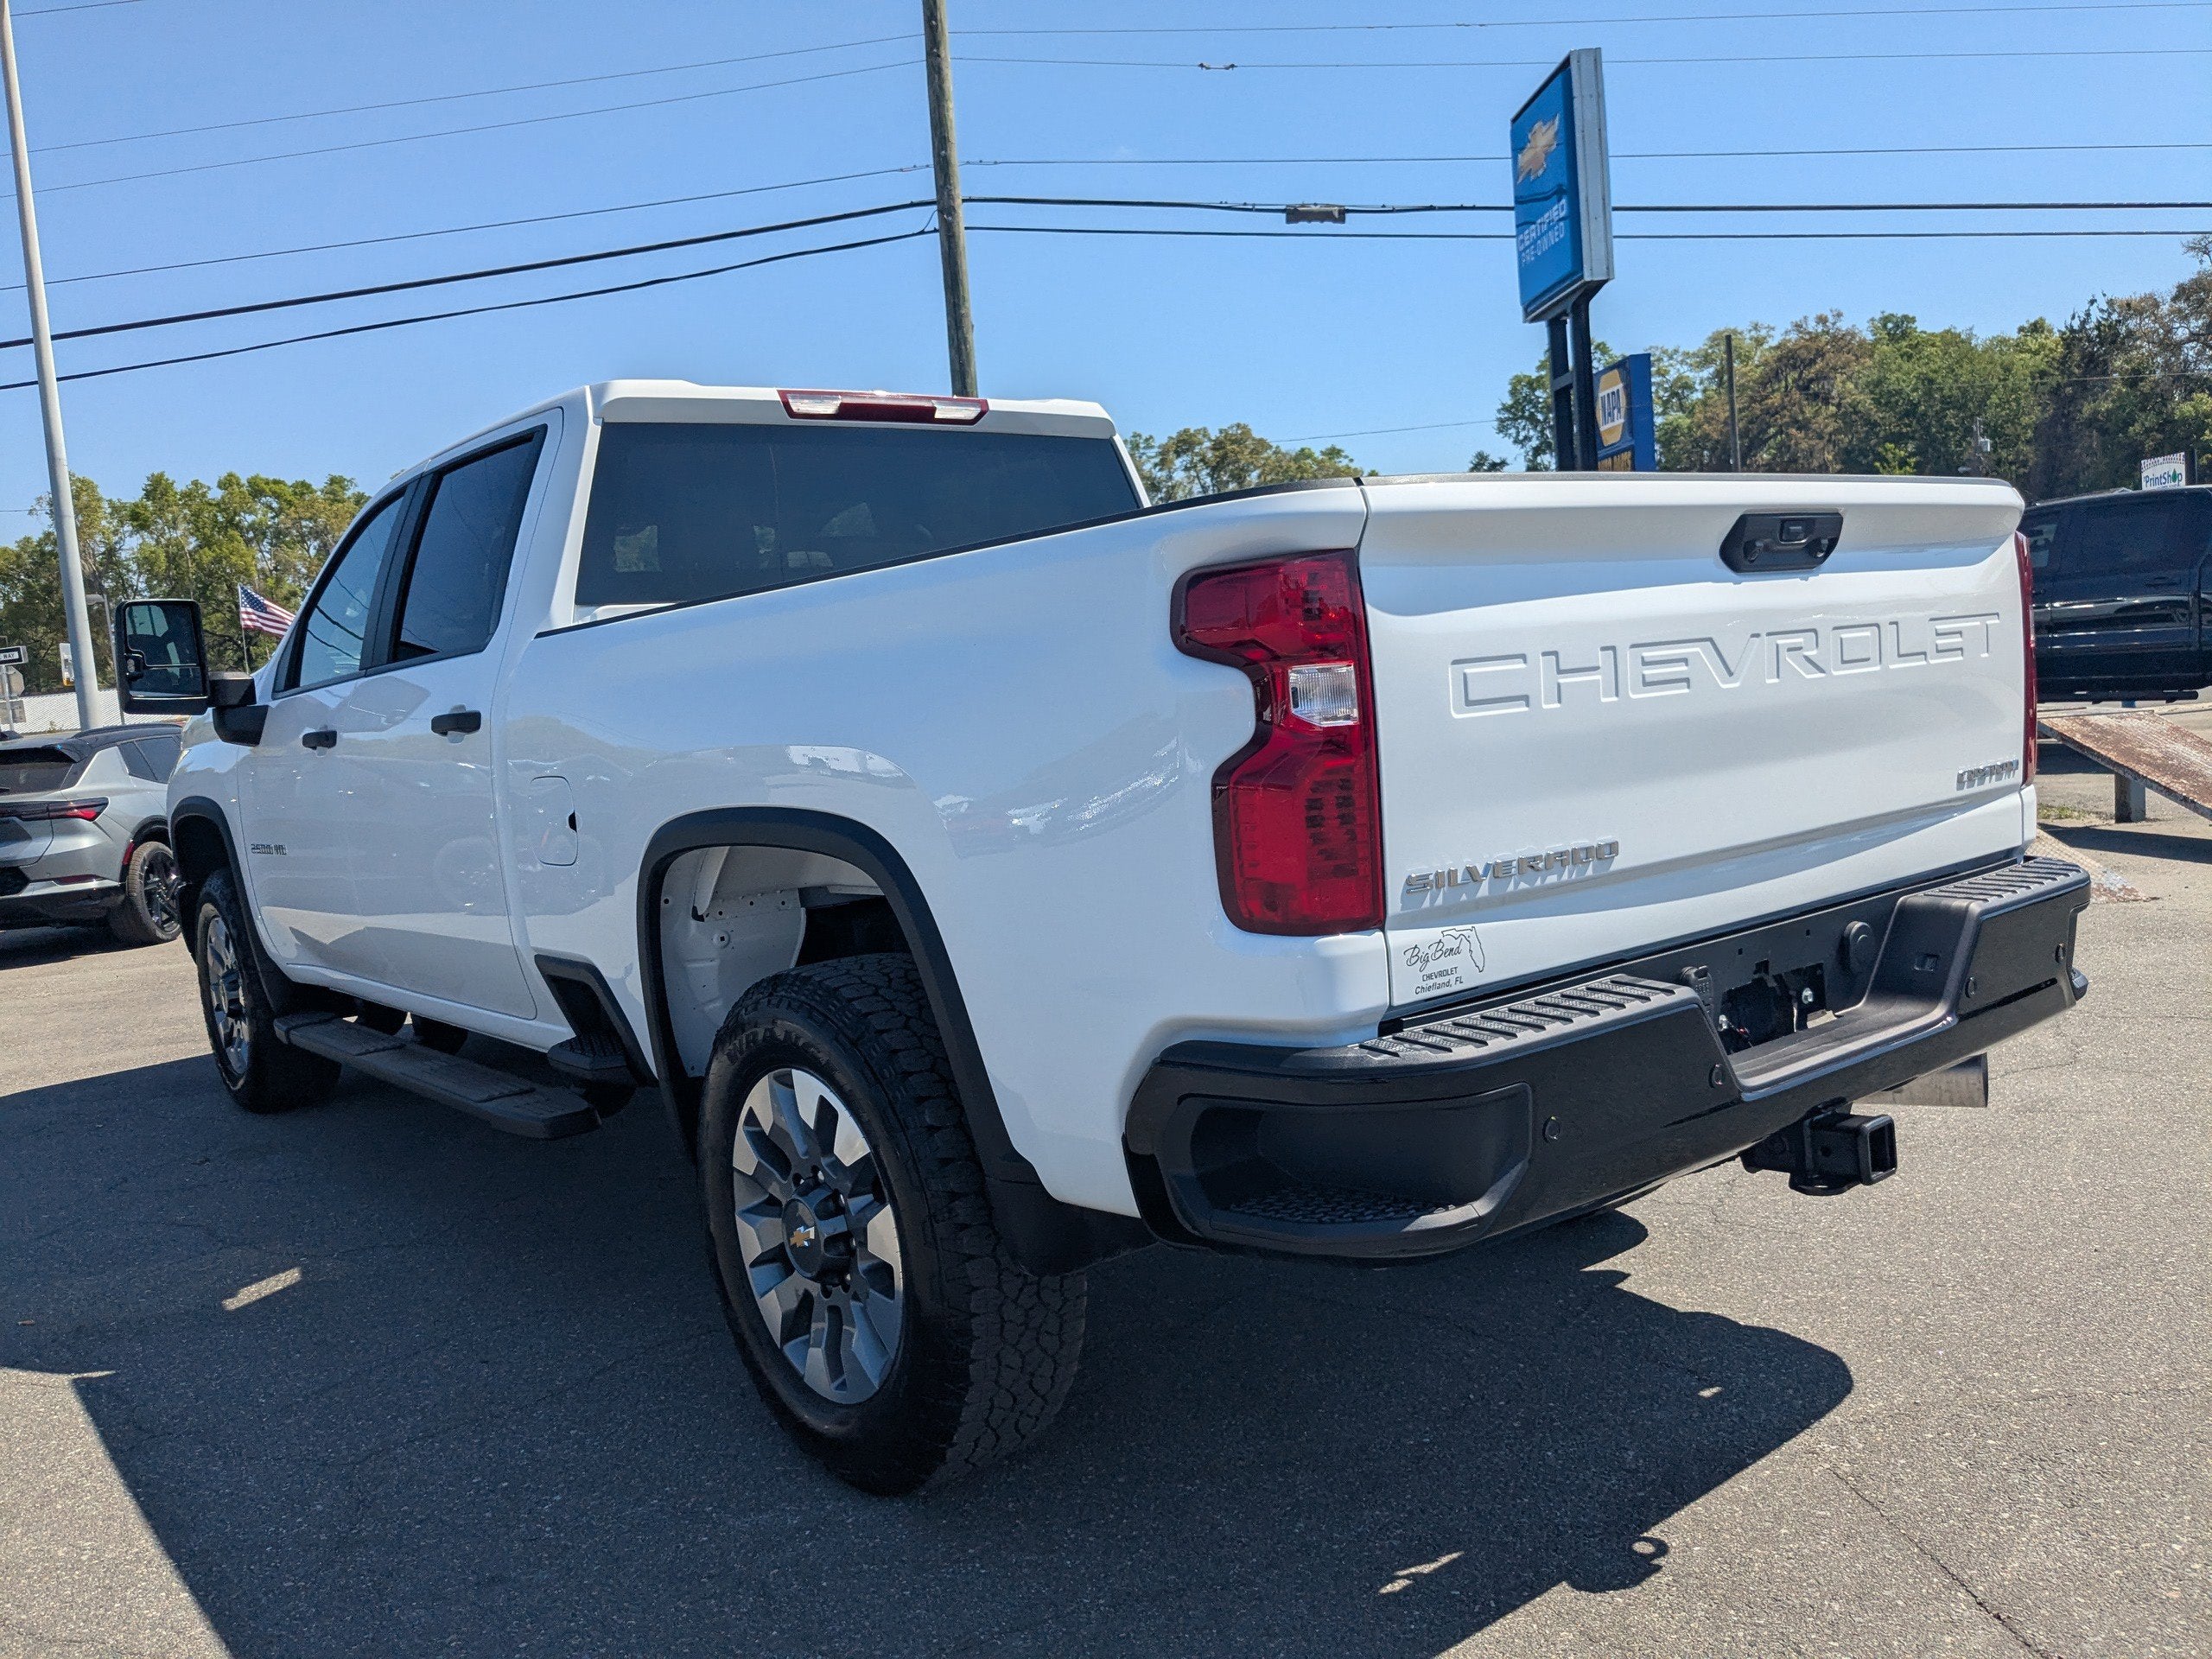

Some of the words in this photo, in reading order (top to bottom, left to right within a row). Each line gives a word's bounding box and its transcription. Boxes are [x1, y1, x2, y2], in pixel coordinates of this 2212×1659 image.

[1518, 196, 1567, 251] CERTIFIED
[1522, 222, 1565, 264] PRE-OWNED
[1601, 389, 1622, 426] NAPA
[1450, 613, 2000, 718] CHEVROLET
[1406, 841, 1618, 894] SILVERADO
[1403, 944, 1430, 972] Big
[1427, 938, 1463, 961] Bend
[1422, 967, 1459, 982] CHEVROLET
[1414, 979, 1452, 995] Chiefland,
[1454, 976, 1464, 985] FL
